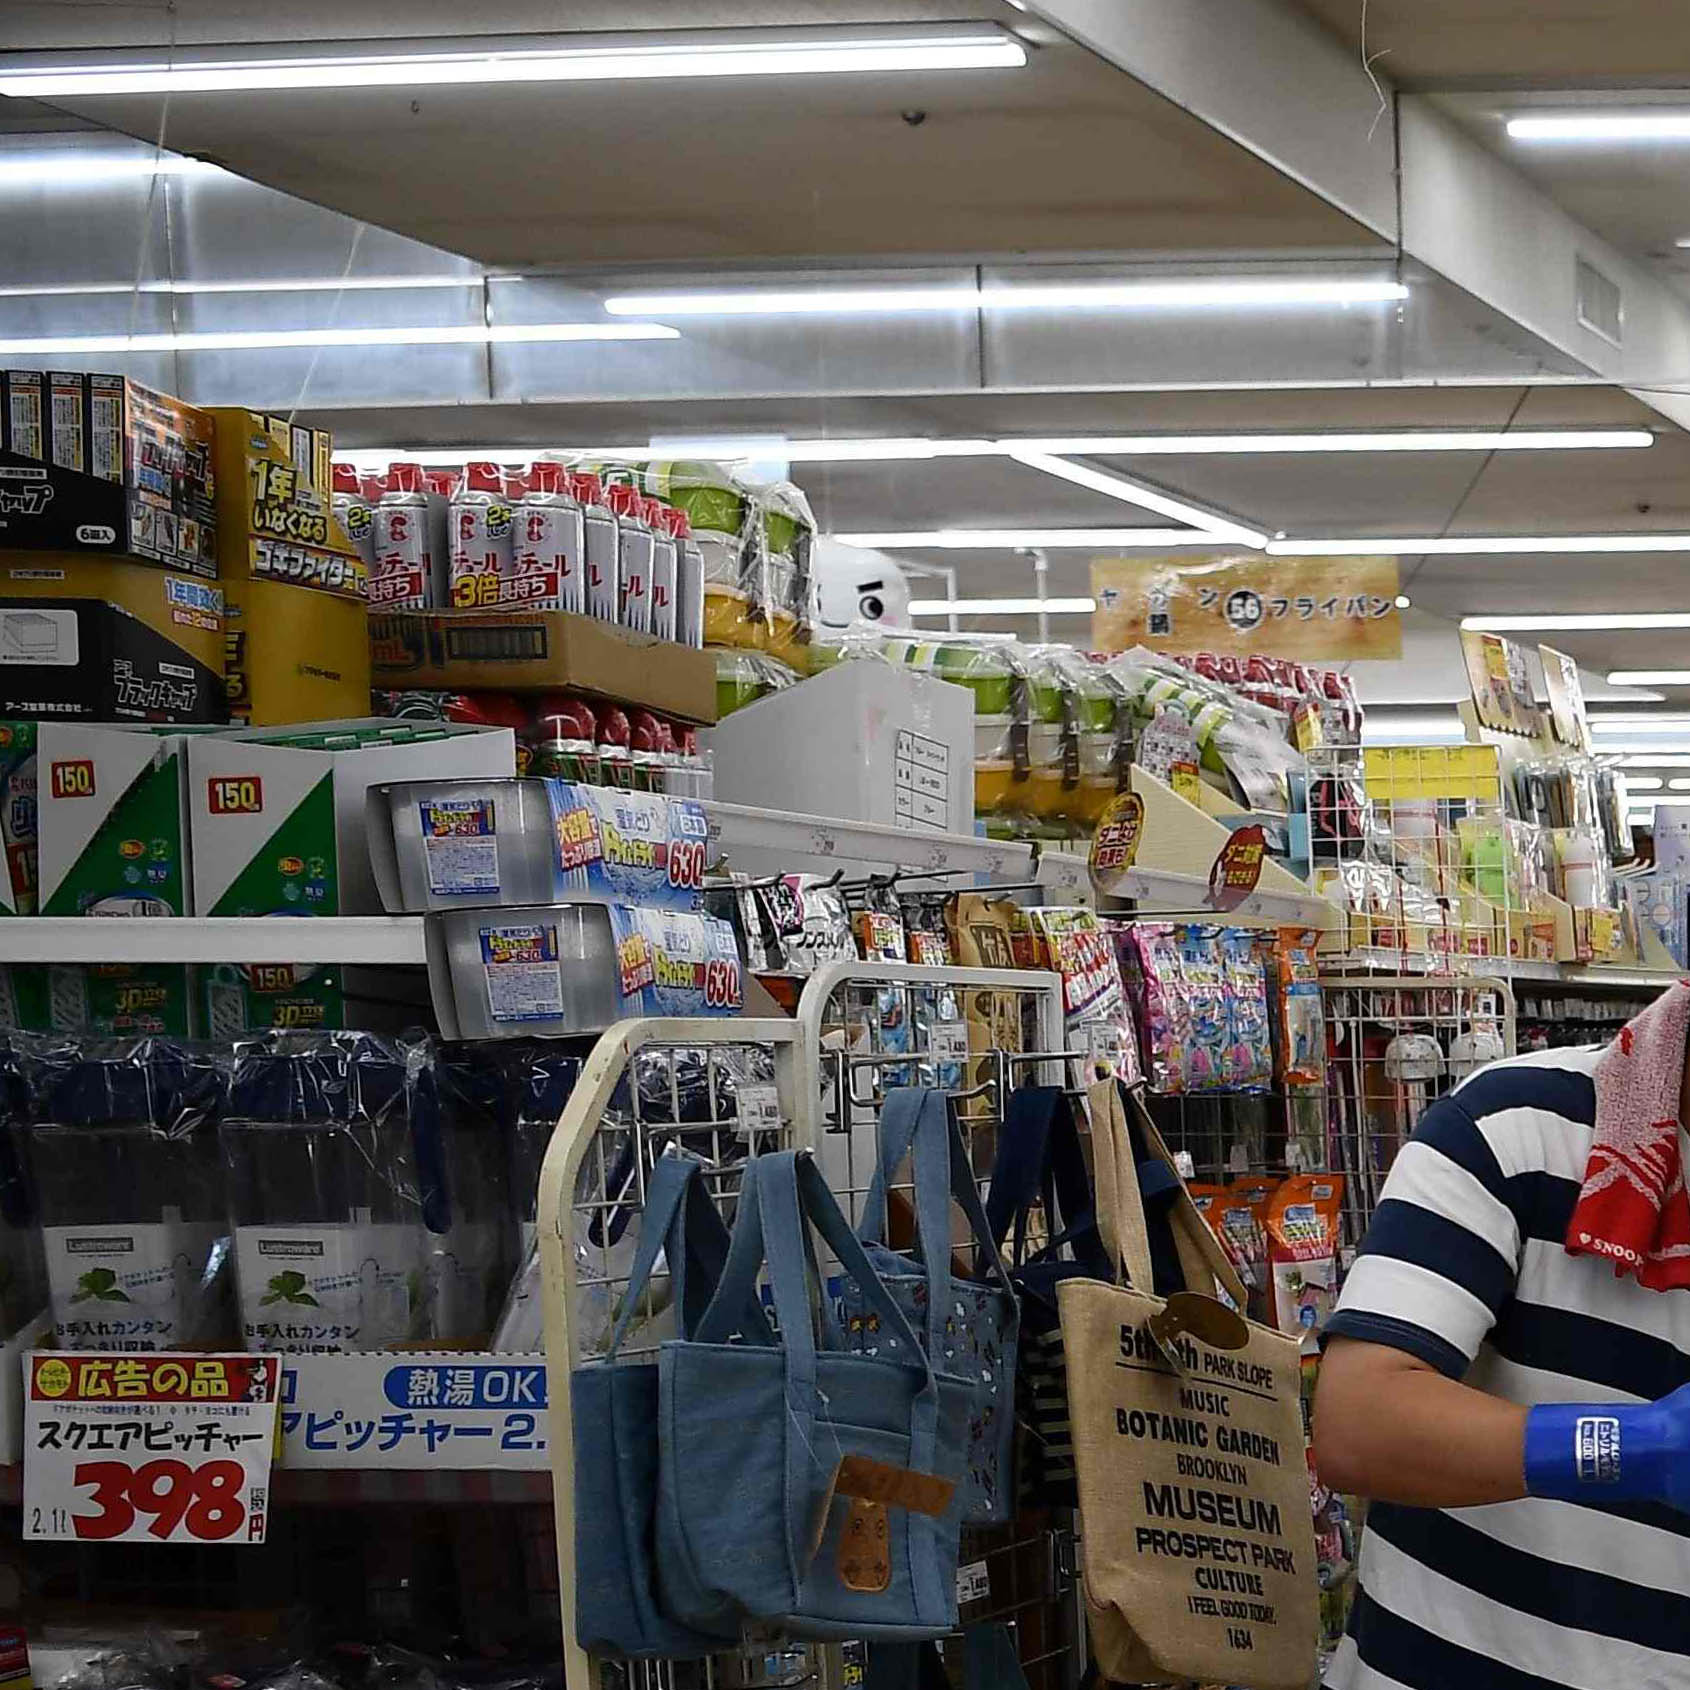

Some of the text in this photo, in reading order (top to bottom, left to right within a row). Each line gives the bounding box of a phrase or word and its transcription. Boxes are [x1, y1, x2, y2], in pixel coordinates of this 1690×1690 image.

[252, 457, 298, 506] 1年
[251, 506, 329, 546] いなくなる
[1230, 596, 1260, 620] 56
[1273, 597, 1393, 619] フライパン
[56, 769, 90, 793] 150
[214, 782, 256, 810] 150
[669, 841, 705, 889] 630
[707, 962, 739, 1006] 630
[78, 1359, 230, 1399] 広告の品
[1203, 1353, 1274, 1390] PARK SLOPE
[1180, 1388, 1231, 1418] MUSIC
[38, 1421, 264, 1451] スクエアピッチャー
[1116, 1408, 1280, 1467] BOTANIC GARDEN
[1177, 1453, 1248, 1487] BROOKLYN
[71, 1459, 246, 1541] 398
[1143, 1481, 1283, 1536] MUSEUM
[1136, 1526, 1297, 1576] PROSPECT PARK
[1195, 1566, 1264, 1597] CULTURE
[1220, 1600, 1248, 1623] GOOD
